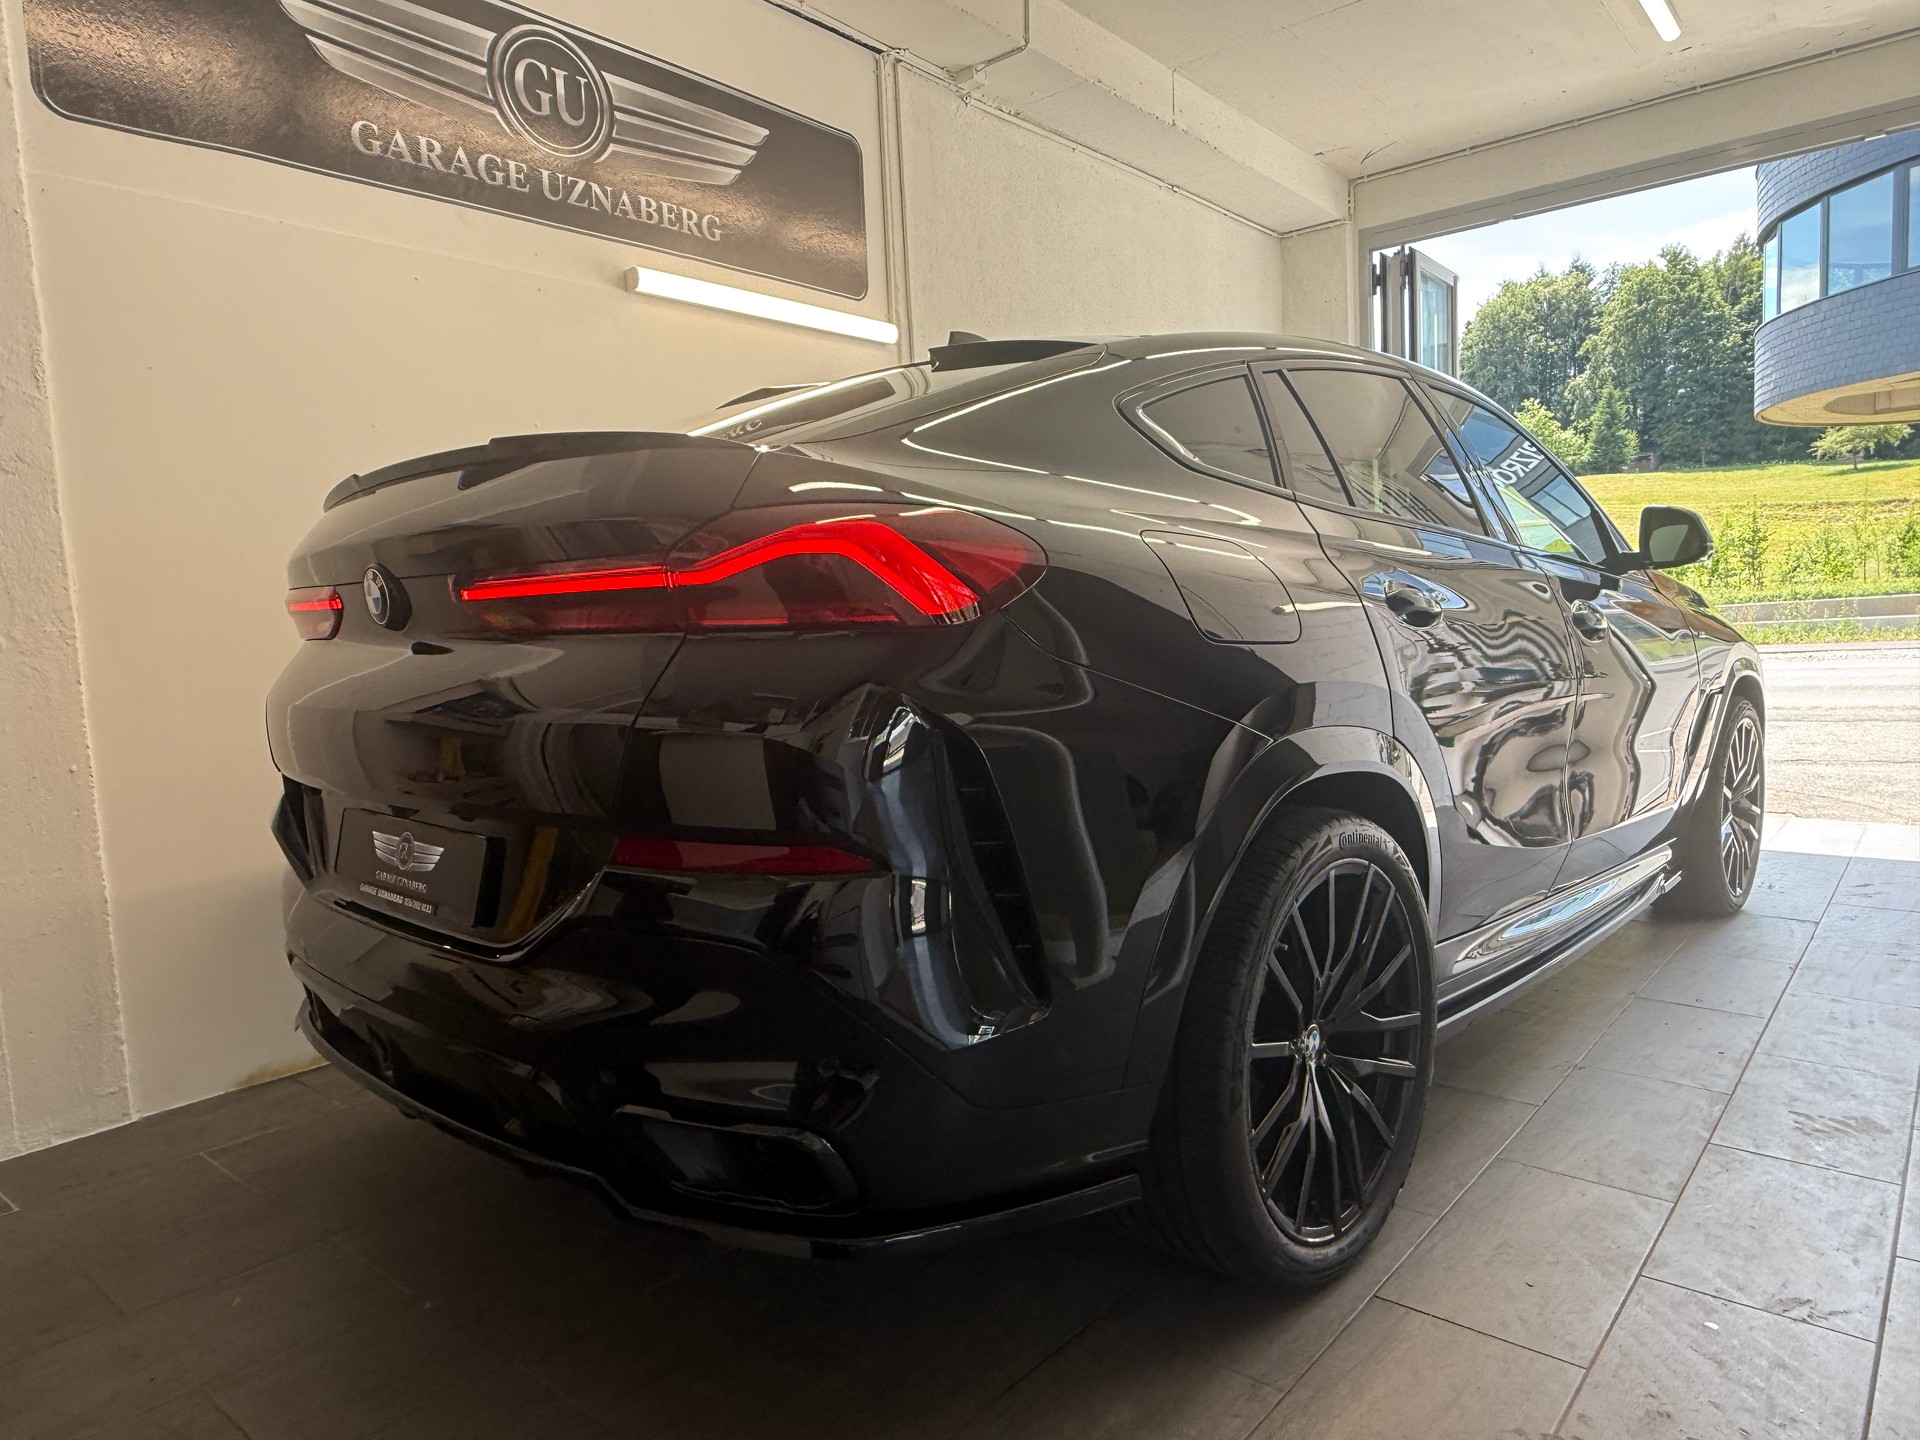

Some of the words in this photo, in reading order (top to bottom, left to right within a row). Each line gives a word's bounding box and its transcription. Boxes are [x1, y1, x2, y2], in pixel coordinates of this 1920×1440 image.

[514, 57, 589, 127] GU
[350, 120, 531, 194] GARAGE
[539, 169, 723, 243] UZNABERG
[1338, 828, 1383, 850] Continental
